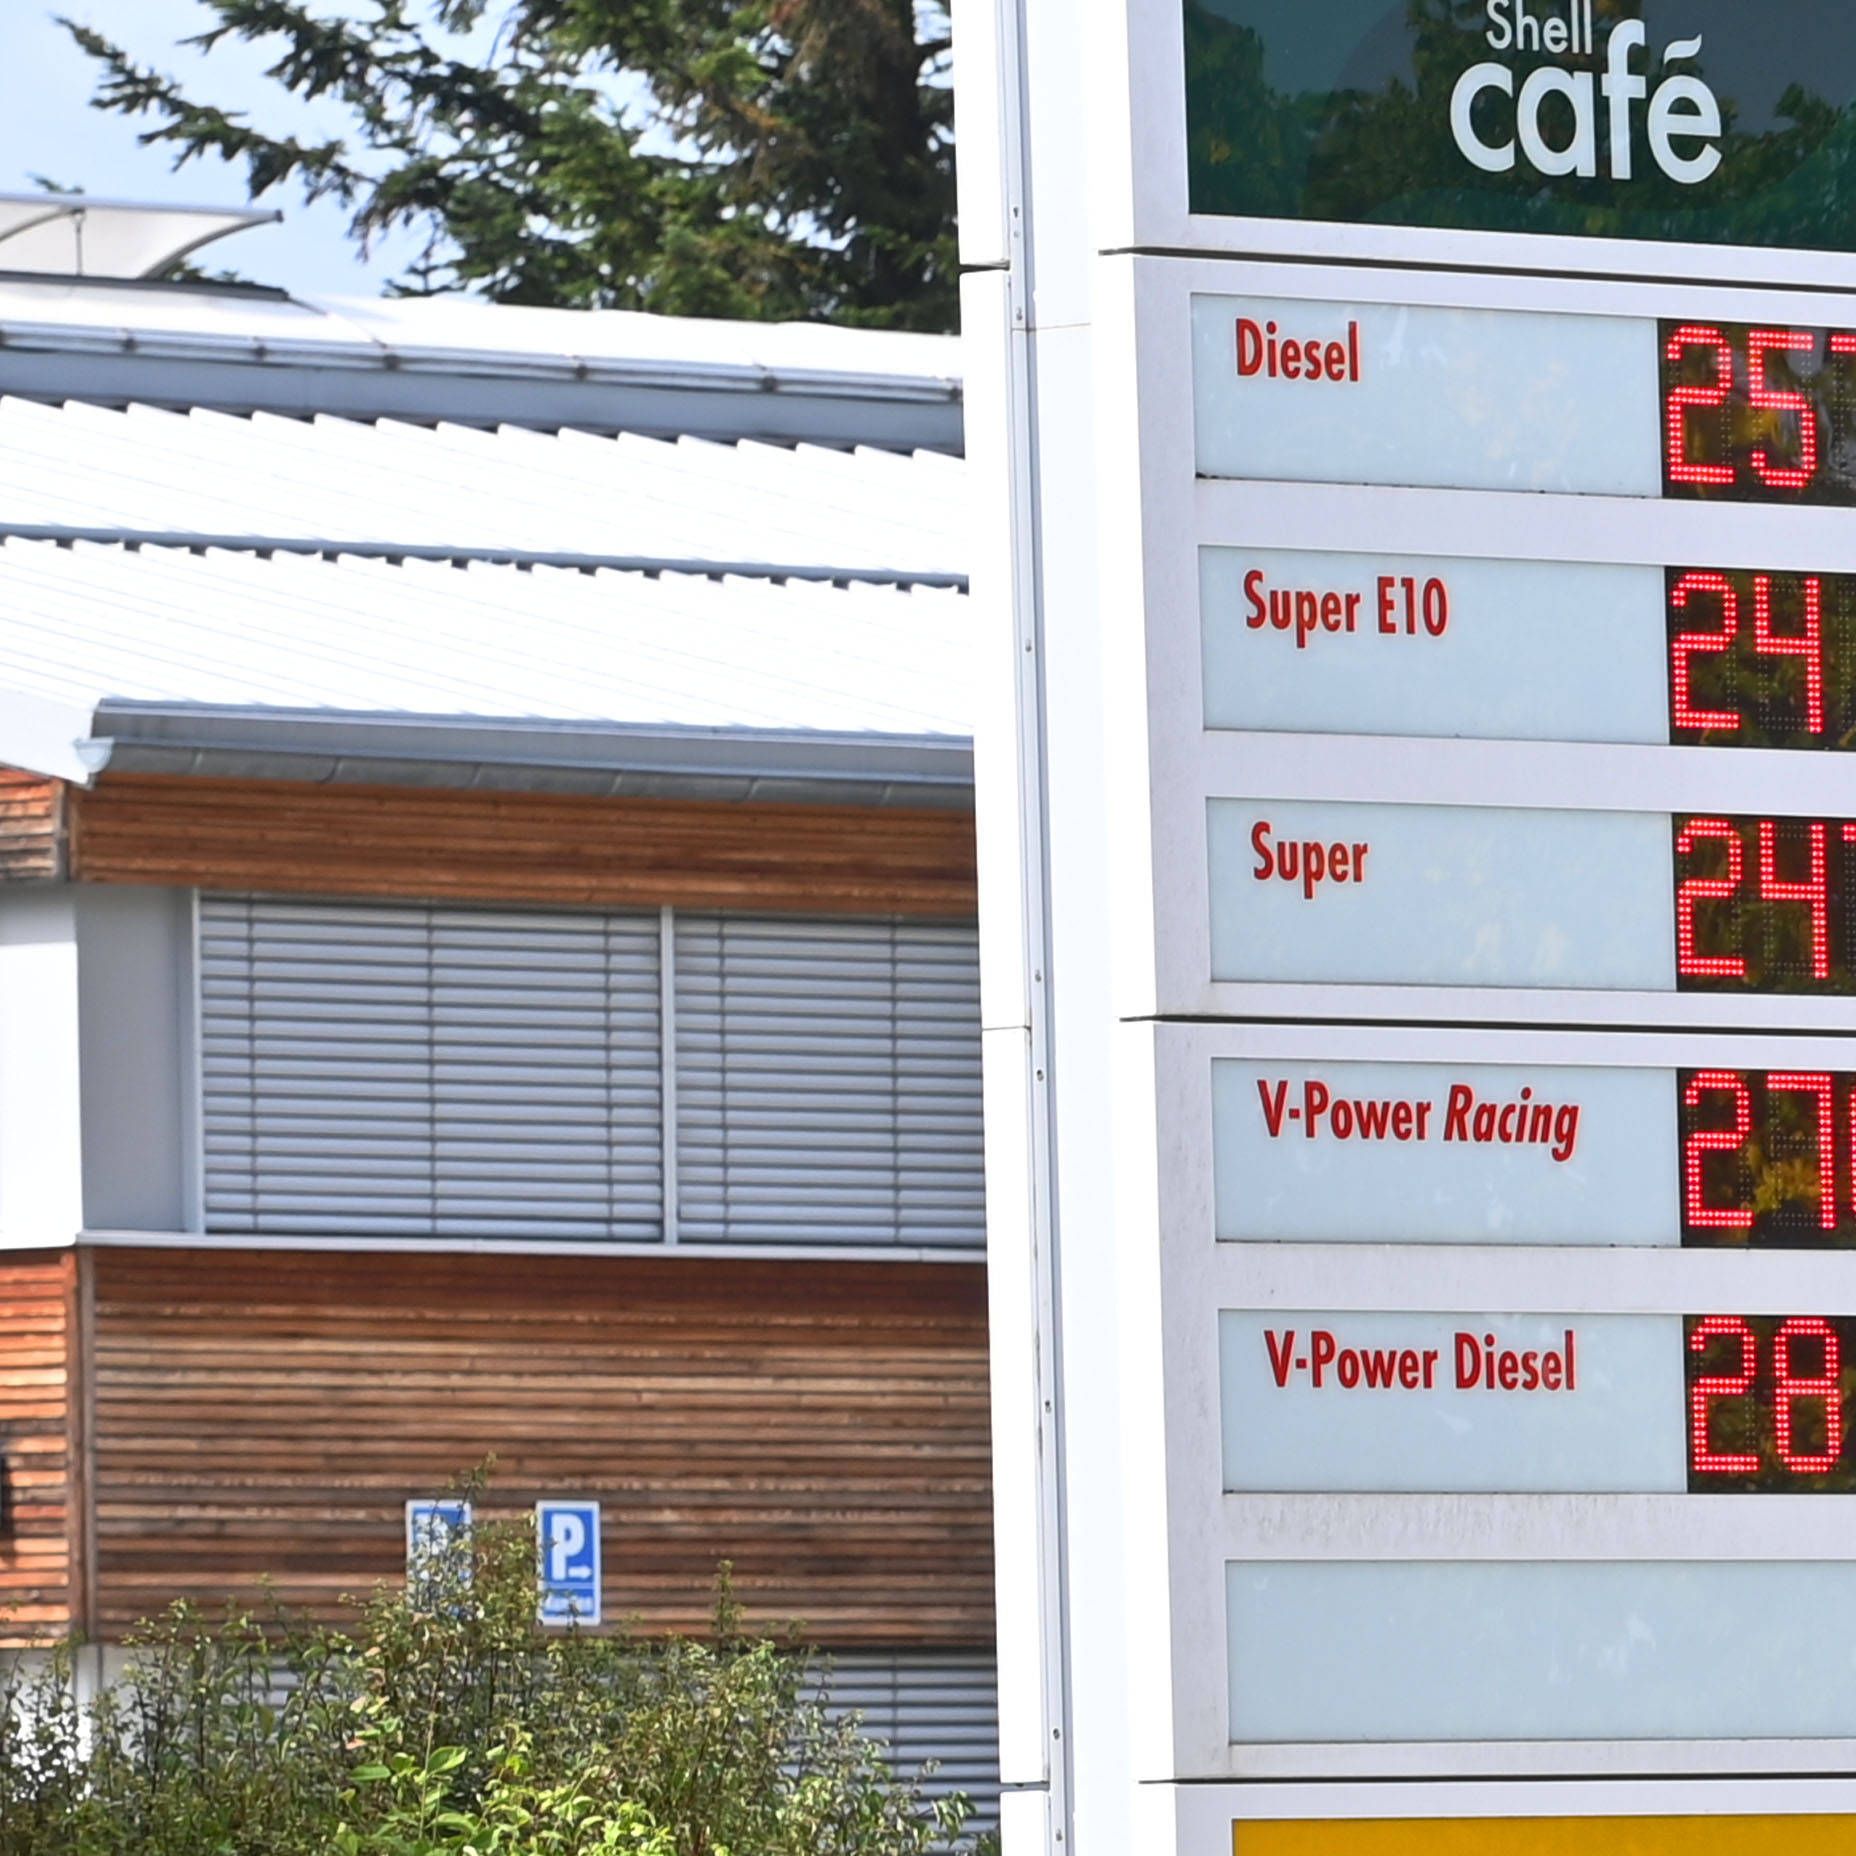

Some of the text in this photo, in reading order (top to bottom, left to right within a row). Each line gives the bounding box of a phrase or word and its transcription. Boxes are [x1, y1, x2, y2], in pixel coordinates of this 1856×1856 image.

[1486, 0, 1593, 54] Shell
[1450, 20, 1722, 184] café
[1235, 318, 1359, 382] Diesel
[1244, 569, 1361, 649] Super
[1377, 575, 1448, 637] E10
[1251, 821, 1368, 900] Super
[1257, 1079, 1432, 1141] V-Power
[1443, 1085, 1580, 1162] Racing
[1263, 1330, 1439, 1390] V-Power
[1454, 1329, 1576, 1391] Diesel
[551, 1513, 585, 1581] P
